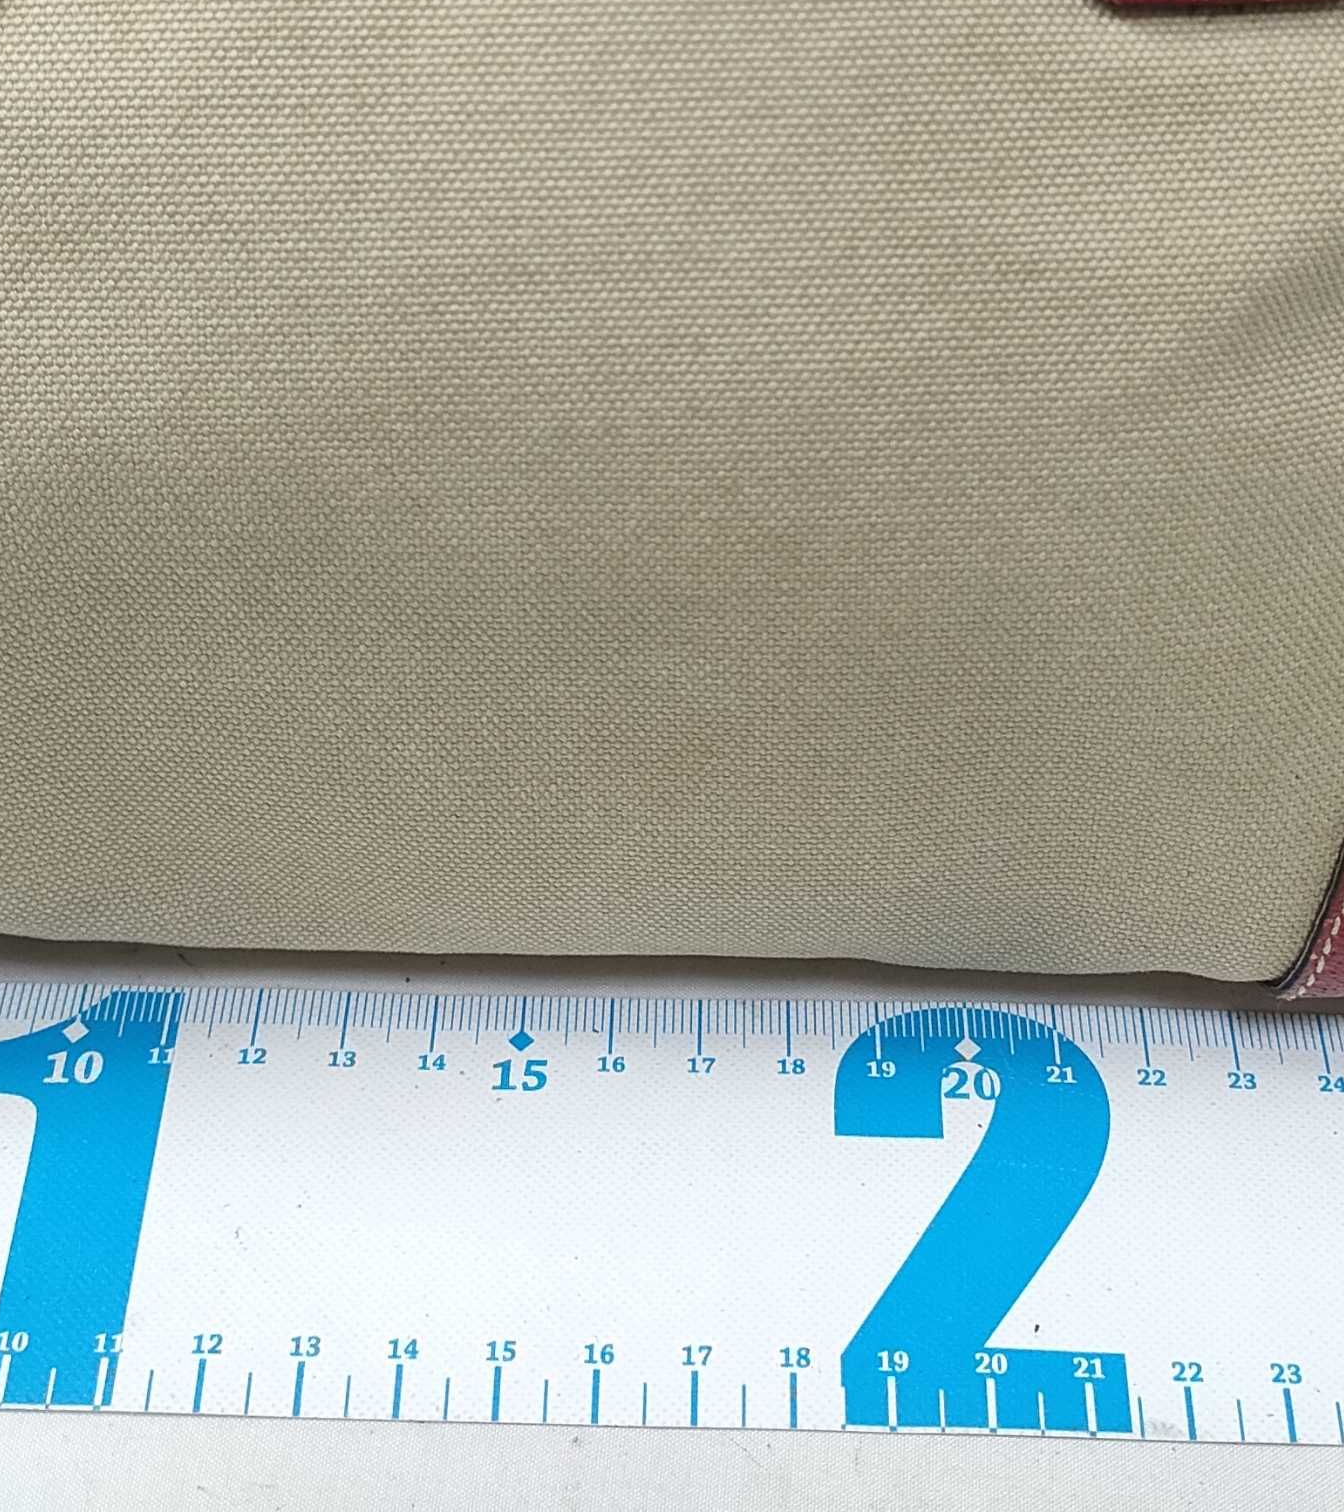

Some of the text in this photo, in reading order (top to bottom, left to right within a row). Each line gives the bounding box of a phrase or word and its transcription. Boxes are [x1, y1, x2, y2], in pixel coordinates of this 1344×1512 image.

[42, 1051, 105, 1084] 10
[148, 1047, 173, 1064] 11
[237, 1048, 267, 1065] 12
[327, 1051, 357, 1067] 13
[417, 1055, 447, 1071] 14
[491, 1059, 549, 1091] 15
[597, 1056, 626, 1073] 16
[686, 1057, 716, 1074] 17
[777, 1058, 806, 1075] 18
[866, 1061, 896, 1078] 19
[942, 1067, 1001, 1100] 20
[1046, 1066, 1077, 1084] 21
[1137, 1068, 1168, 1087] 22
[1227, 1072, 1257, 1090] 23
[834, 1007, 1133, 1434] 2
[93, 1333, 124, 1353] 11
[192, 1334, 223, 1355] 12
[289, 1336, 321, 1357] 13
[387, 1339, 419, 1359] 14
[485, 1341, 517, 1362] 15
[583, 1344, 615, 1364] 16
[681, 1346, 713, 1366] 17
[779, 1348, 811, 1369] 18
[876, 1351, 910, 1372] 19
[974, 1354, 1008, 1375] 20
[1072, 1357, 1106, 1379] 21
[1171, 1362, 1204, 1383] 22
[1270, 1364, 1302, 1385] 23
